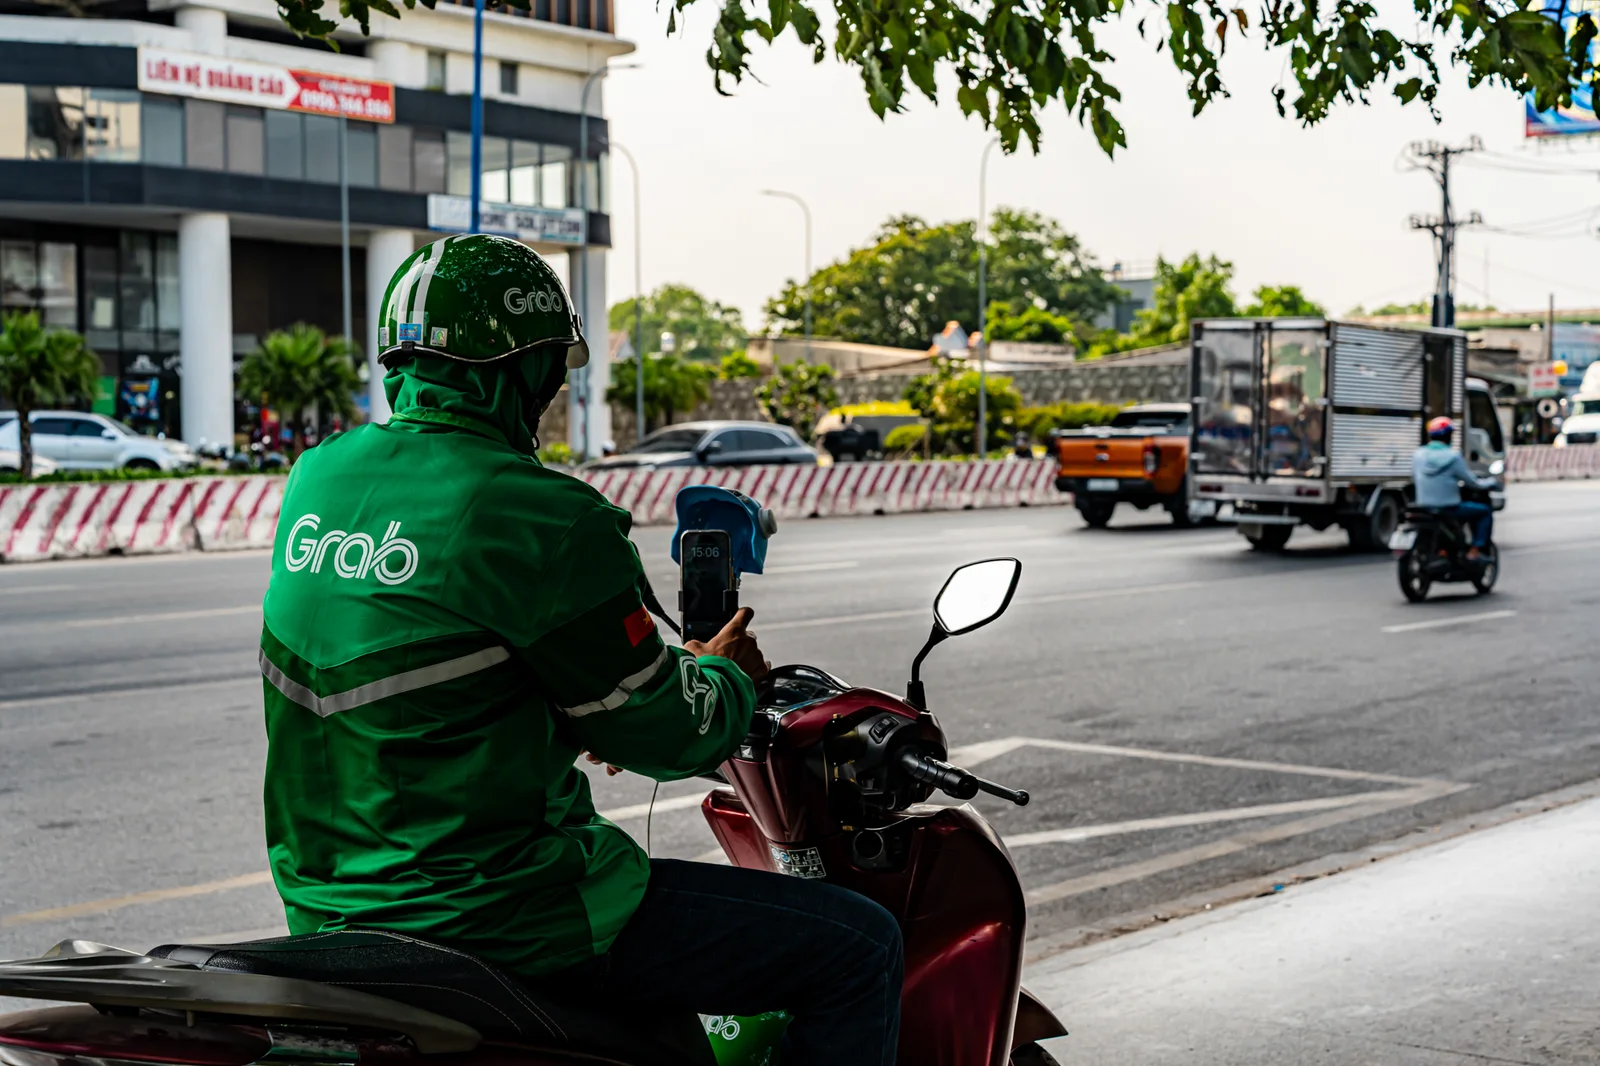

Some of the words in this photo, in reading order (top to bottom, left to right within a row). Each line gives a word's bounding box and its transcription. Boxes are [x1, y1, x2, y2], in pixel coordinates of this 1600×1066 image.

[503, 283, 563, 315] Grab
[285, 513, 419, 586] Grab
[691, 546, 720, 558] 15:06
